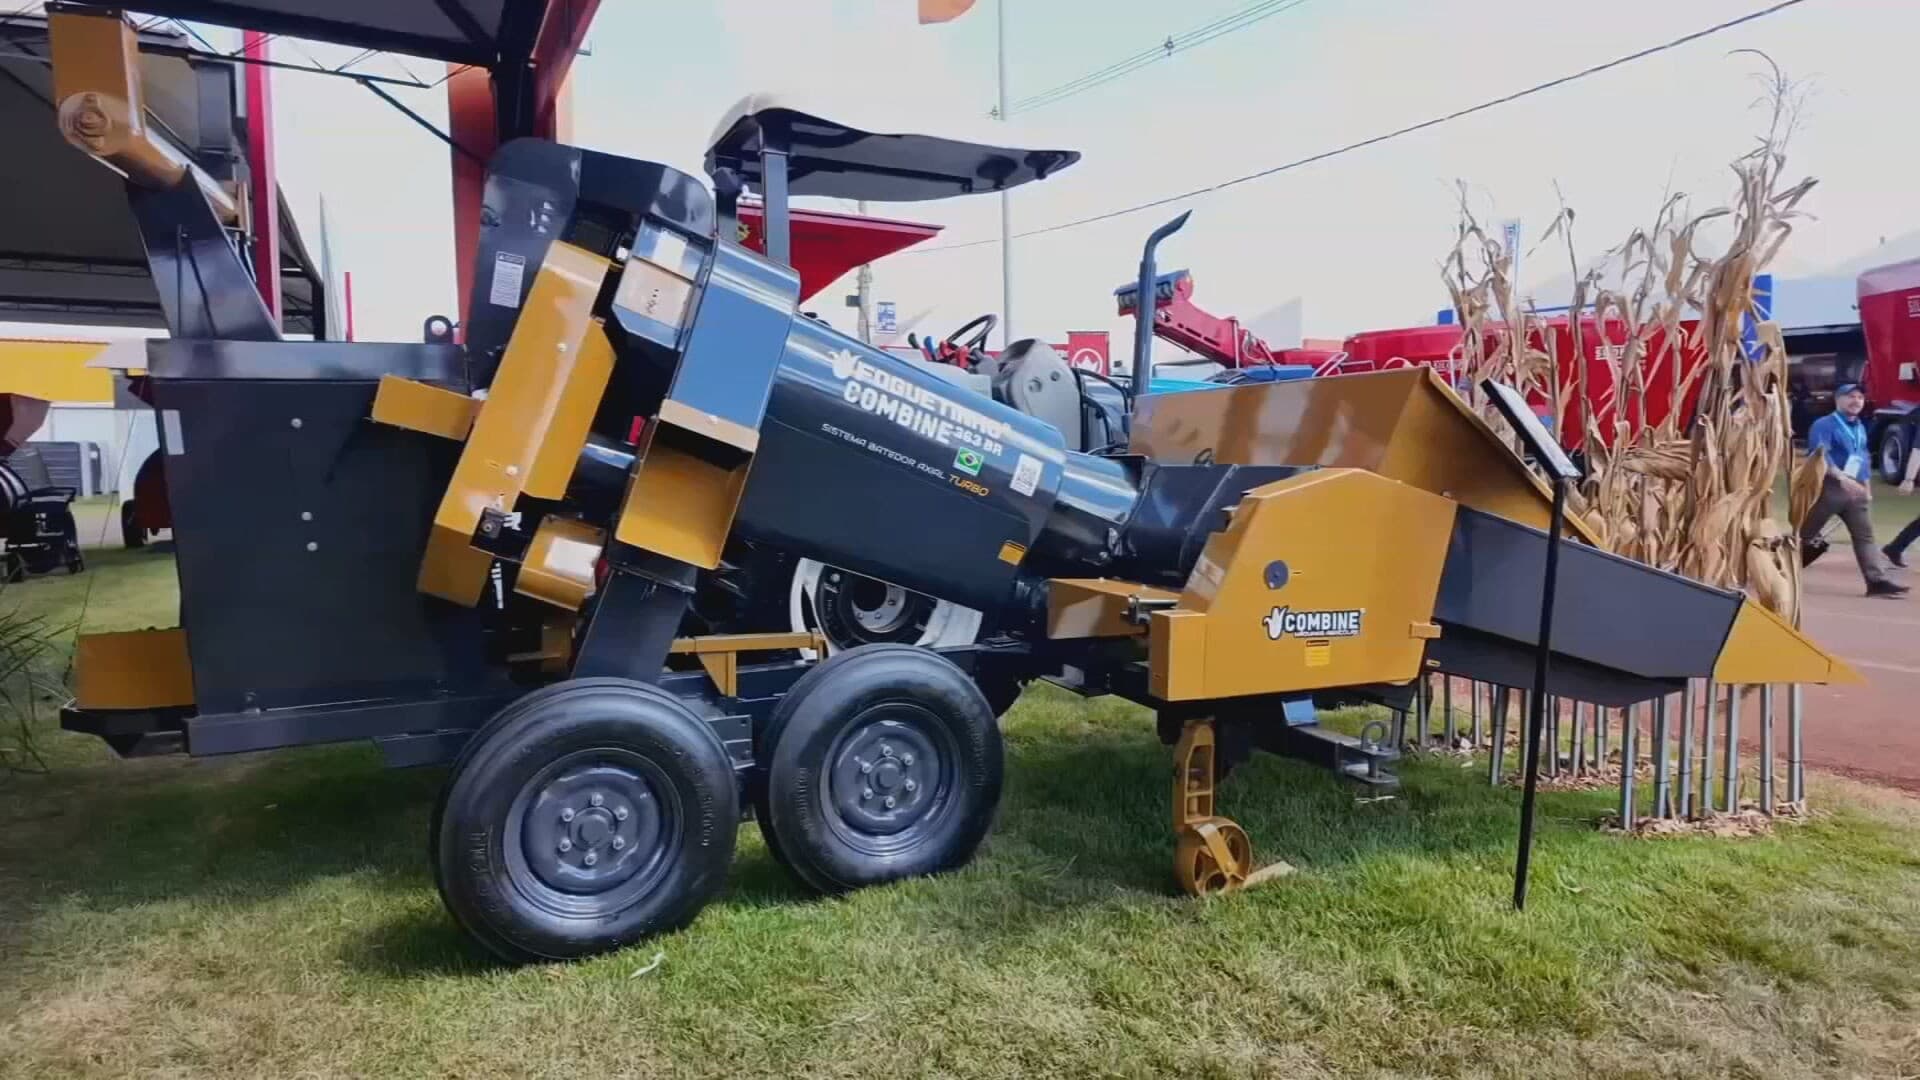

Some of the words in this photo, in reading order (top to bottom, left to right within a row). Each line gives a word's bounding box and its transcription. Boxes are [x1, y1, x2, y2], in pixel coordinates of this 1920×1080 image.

[844, 381, 954, 445] COMBINE
[983, 438, 1003, 457] BR
[821, 423, 867, 447] SISTEMA
[867, 441, 916, 467] BATEDOR
[917, 462, 945, 480] AXIAL
[949, 473, 990, 497] TURBO
[1285, 611, 1360, 632] COMBINE
